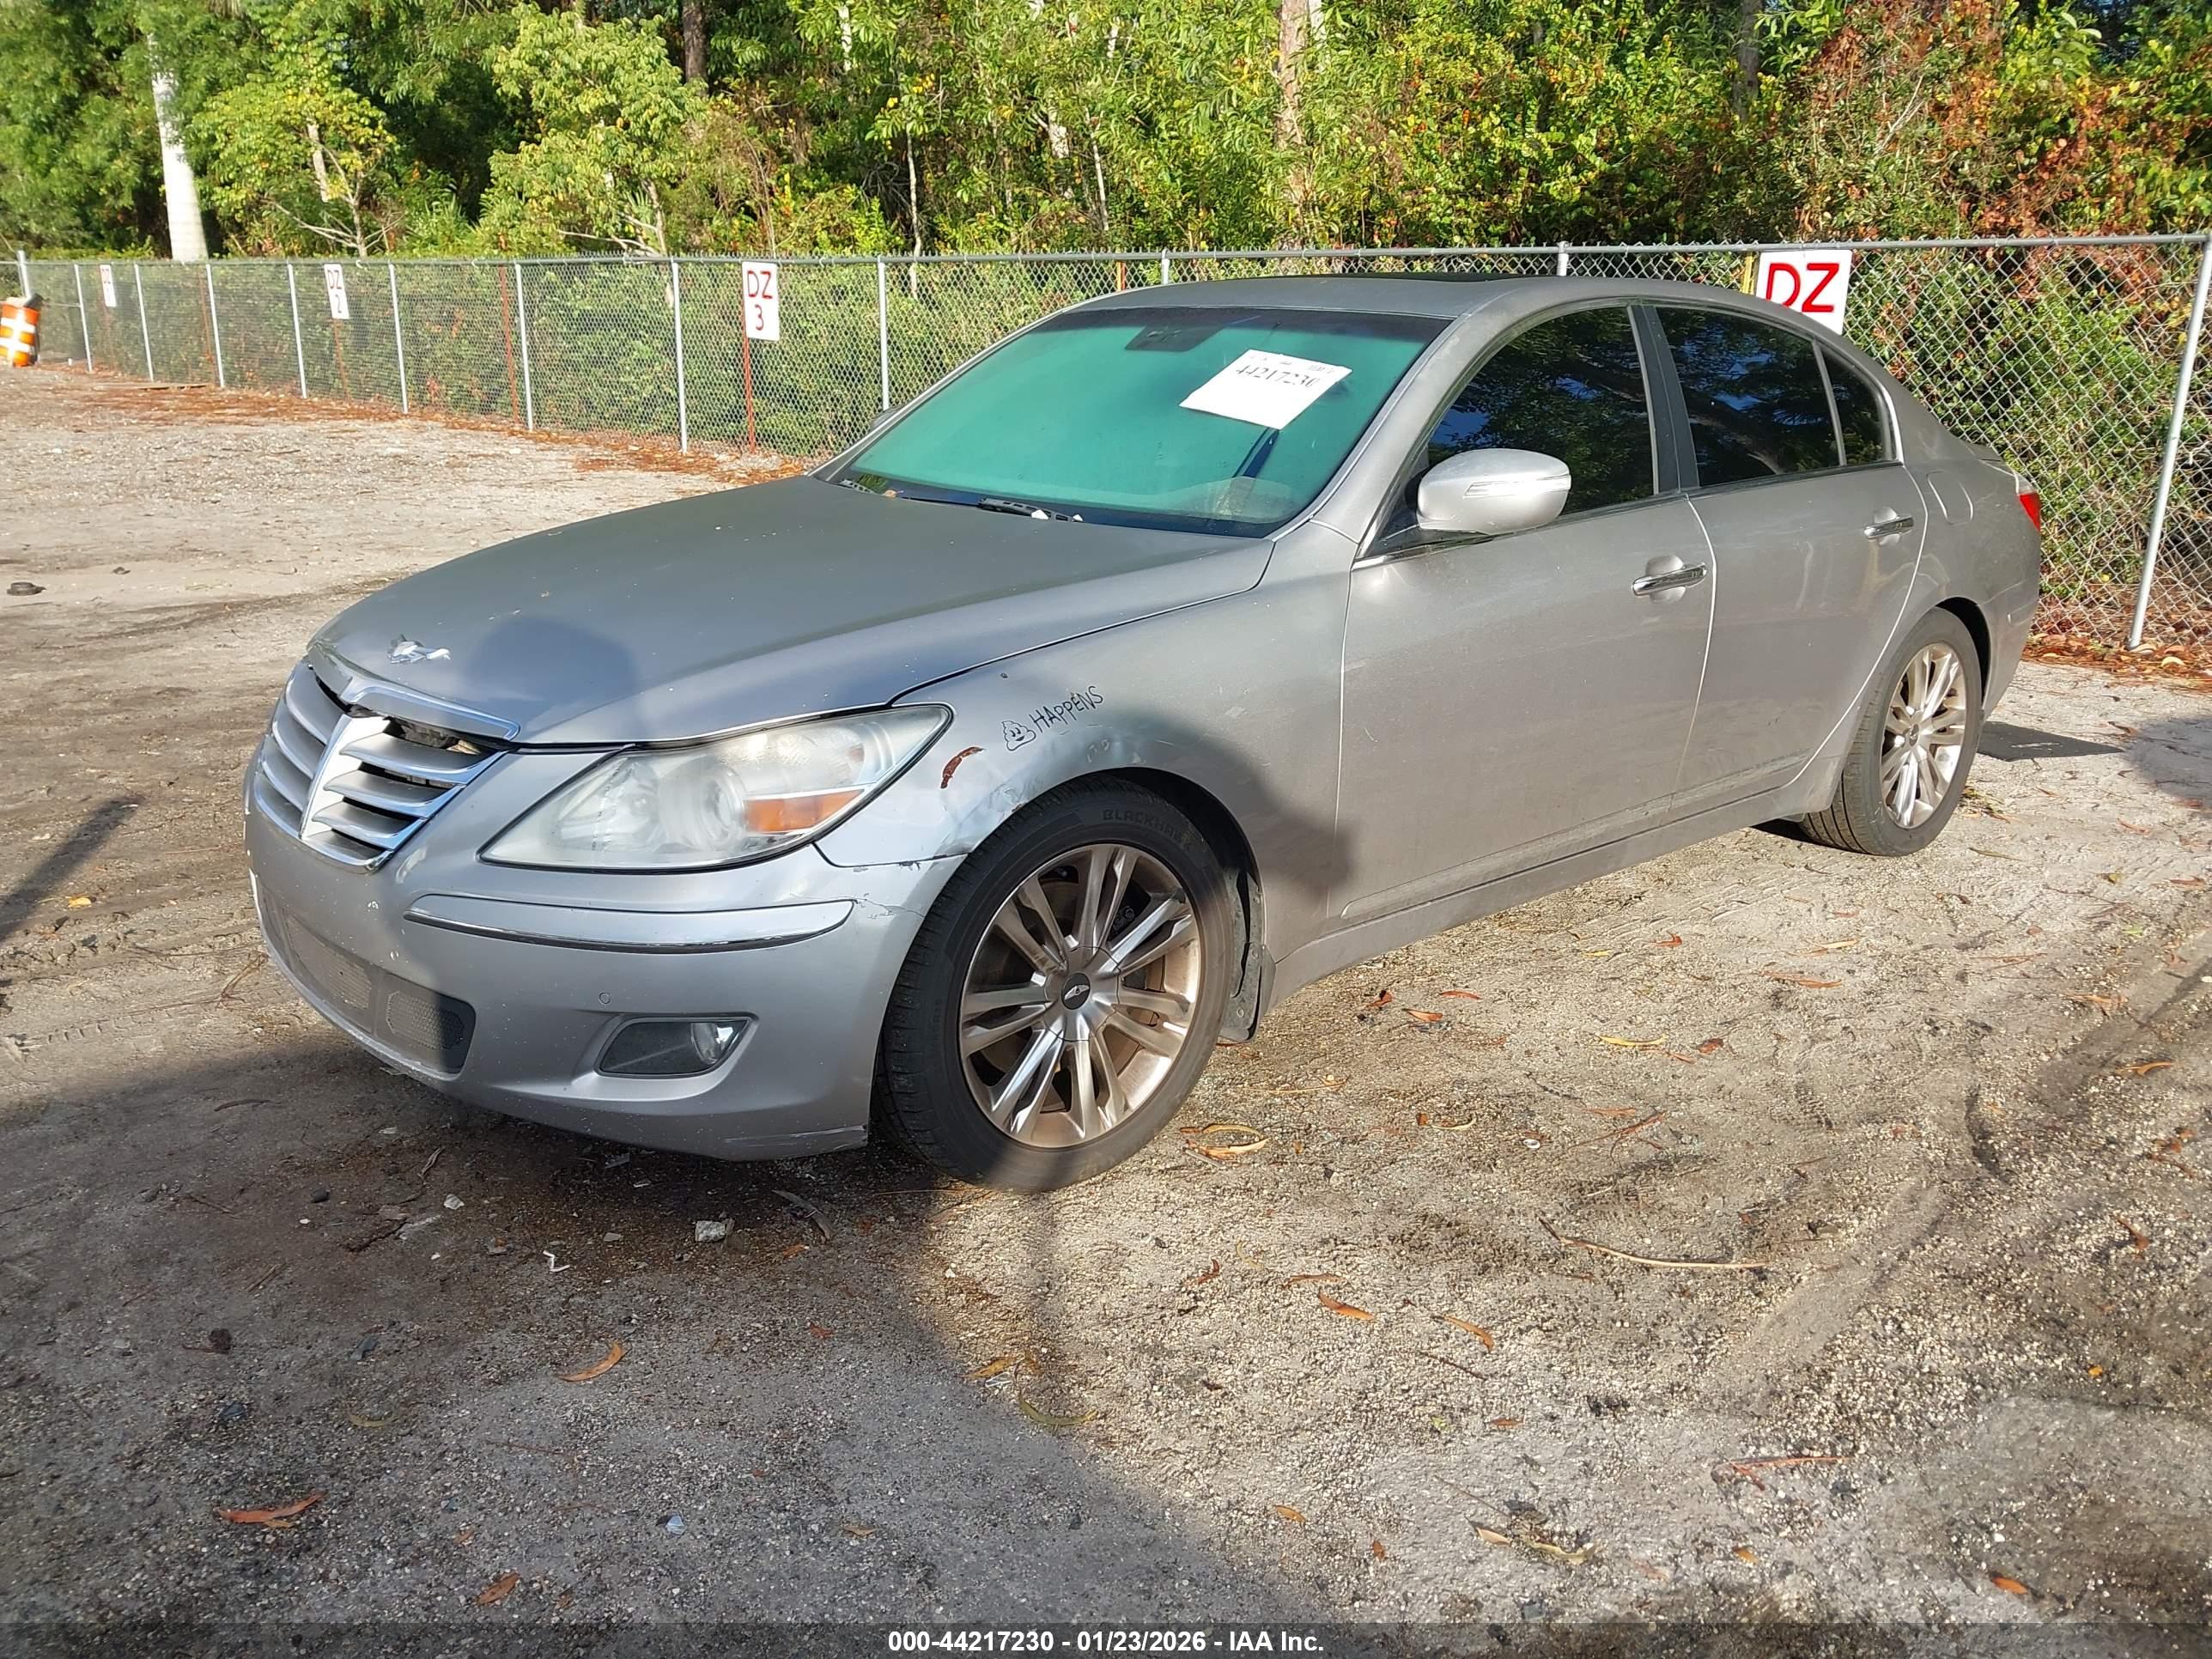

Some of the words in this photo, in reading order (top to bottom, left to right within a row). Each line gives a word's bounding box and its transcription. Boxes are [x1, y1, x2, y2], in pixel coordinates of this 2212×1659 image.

[747, 270, 773, 299] DZ
[1765, 262, 1840, 313] DZ
[754, 303, 764, 331] 3
[1028, 685, 1104, 732] HAPPENS
